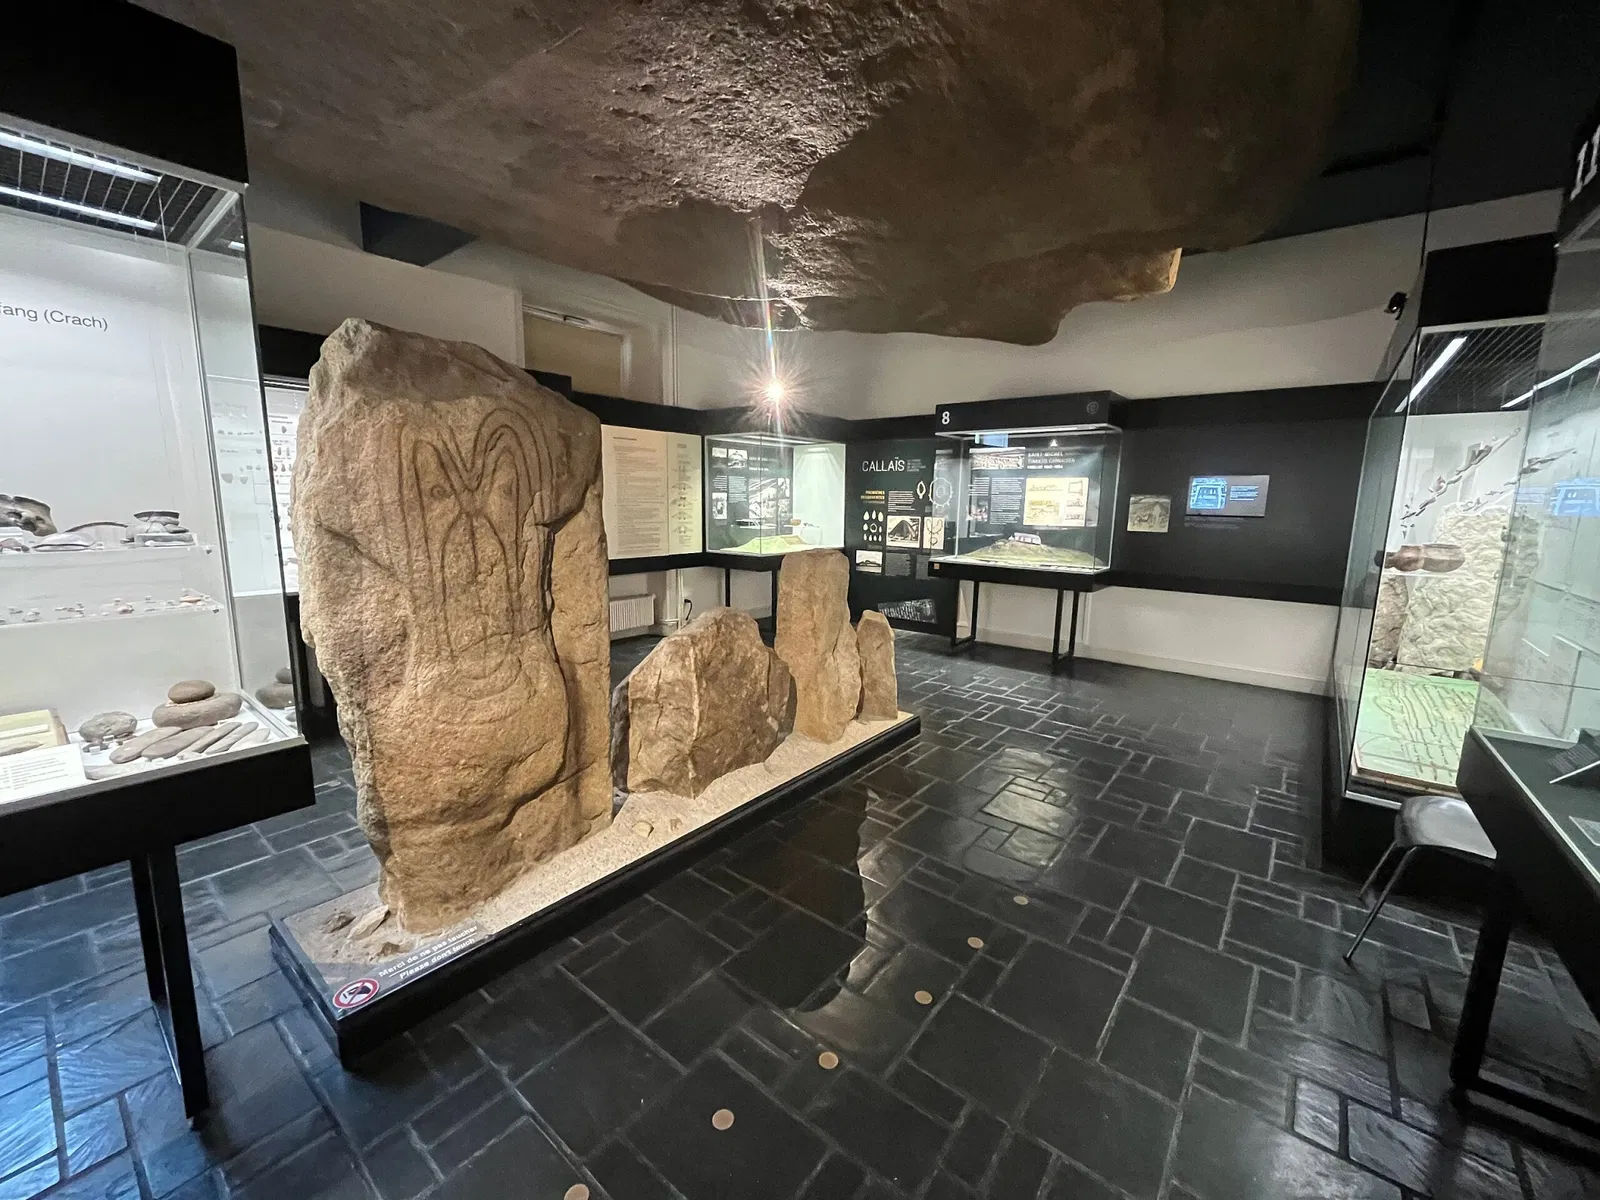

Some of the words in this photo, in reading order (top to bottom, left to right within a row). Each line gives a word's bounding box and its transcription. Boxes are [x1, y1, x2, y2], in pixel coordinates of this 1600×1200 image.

[44, 309, 108, 332] (Crach)
[941, 411, 950, 425] 8
[862, 456, 905, 471] CALLAÏS
[379, 962, 405, 977] Merci
[407, 955, 418, 964] de
[419, 949, 432, 957] ne
[432, 941, 448, 952] pas
[448, 927, 477, 942] toucher
[400, 962, 429, 979] Please
[453, 939, 475, 952] touch
